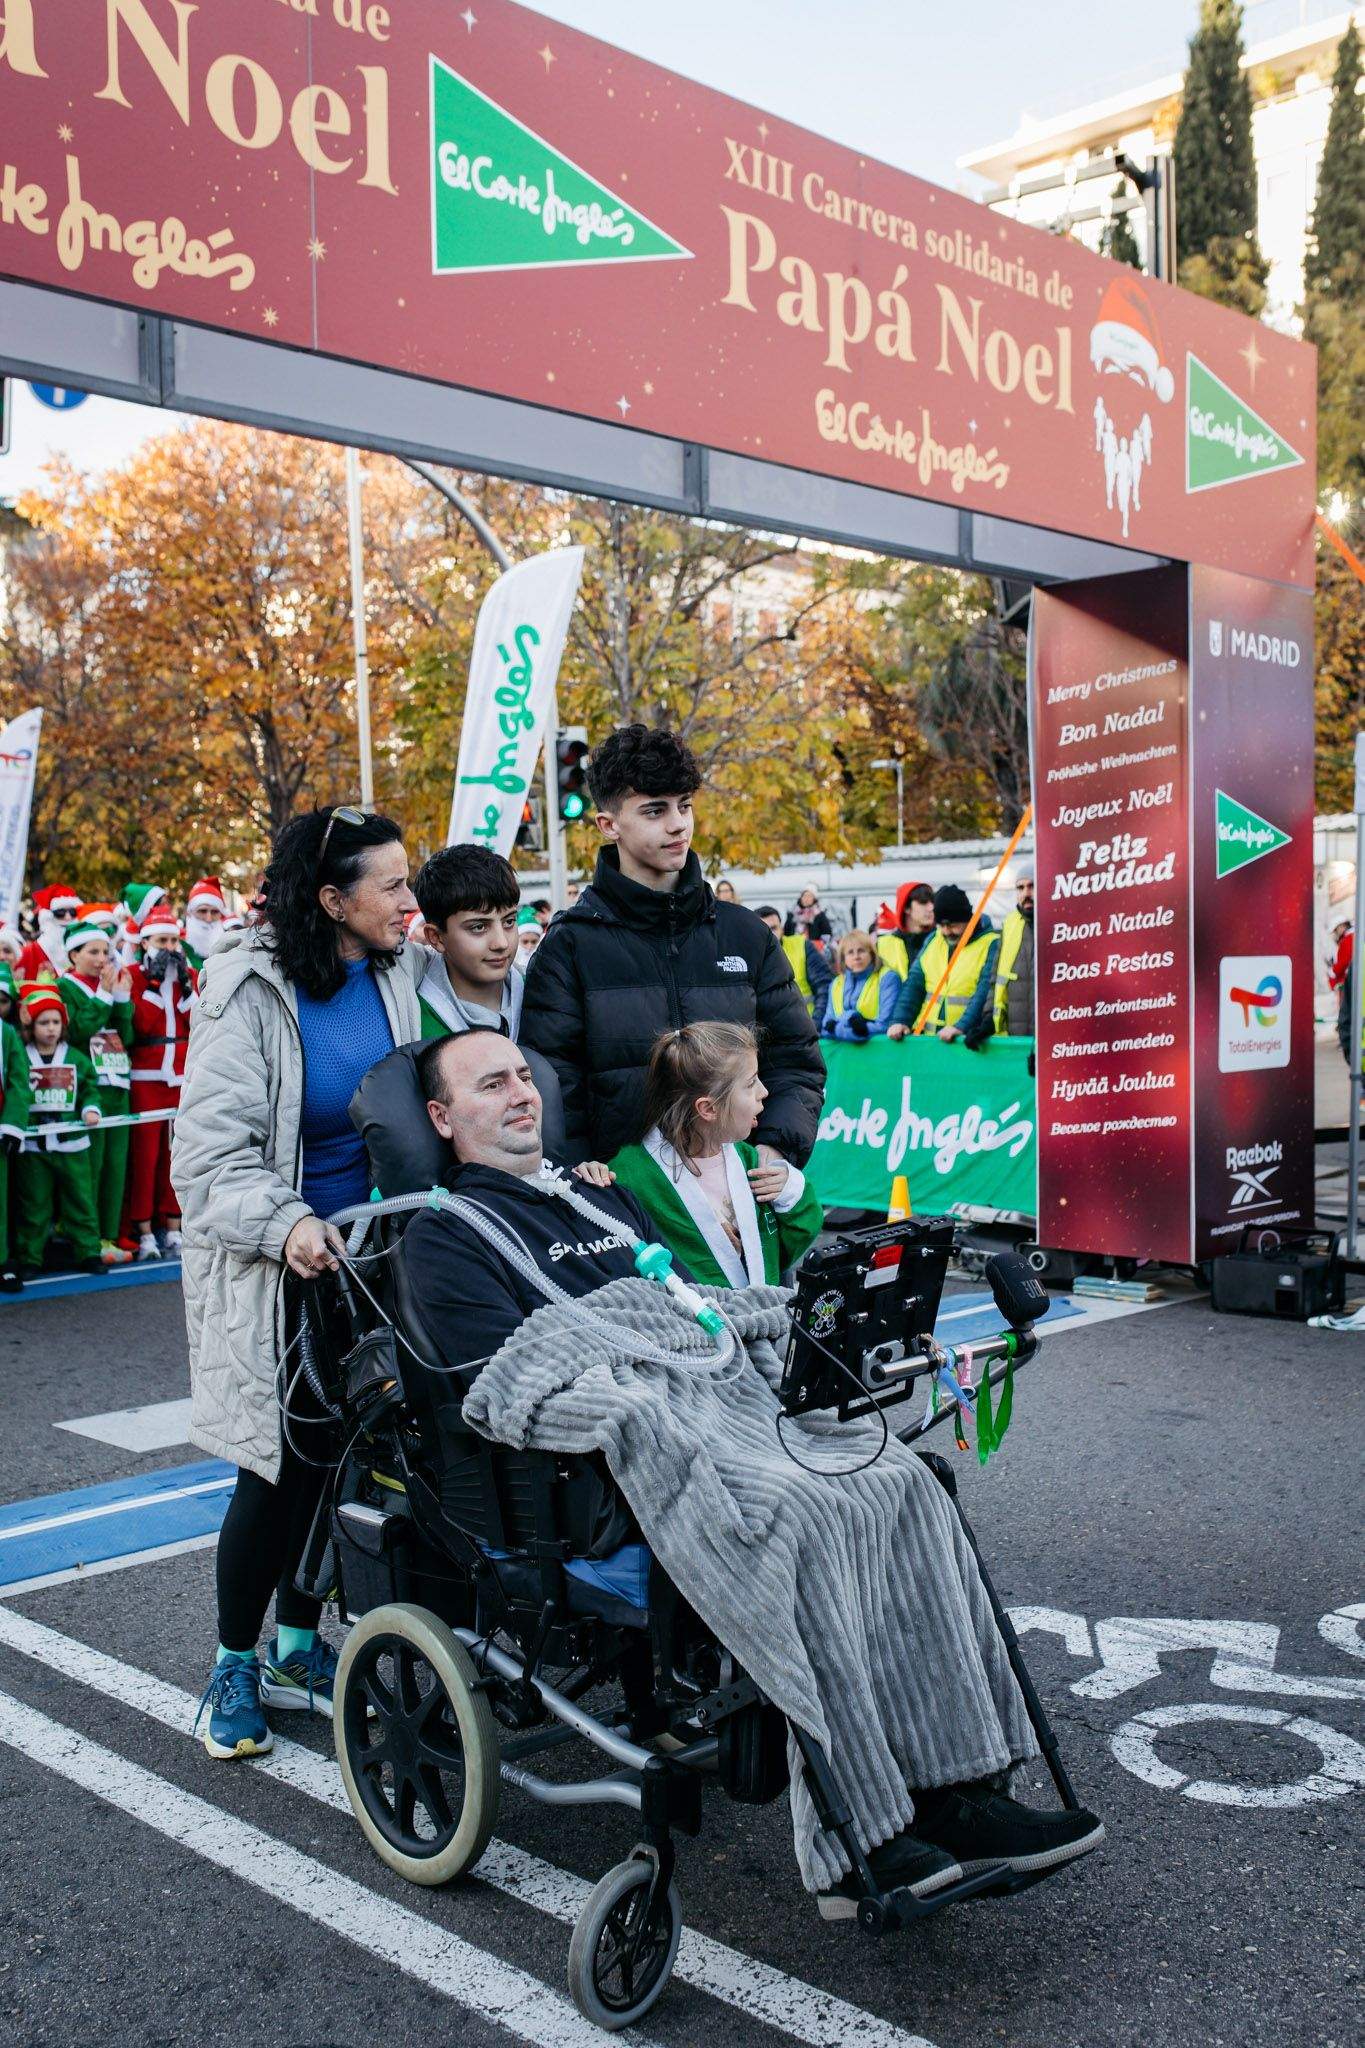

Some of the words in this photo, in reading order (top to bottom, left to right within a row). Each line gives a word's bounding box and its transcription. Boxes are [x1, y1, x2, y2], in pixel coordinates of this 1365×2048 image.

[94, 0, 399, 197] Noel
[438, 141, 471, 191] El
[471, 156, 541, 215] Corte
[542, 168, 635, 245] Inglés
[724, 137, 794, 203] XIII
[802, 172, 919, 251] Carrera
[925, 229, 1039, 298] solidaria
[1044, 269, 1074, 310] de
[720, 204, 918, 374] Papá
[934, 283, 1076, 416] Noel
[815, 388, 849, 444] El
[848, 401, 917, 464] Corte
[918, 408, 1010, 493] Inglés
[1204, 412, 1236, 448] Corte
[1235, 414, 1279, 463] Inglés
[1231, 628, 1301, 668] MADRID
[1047, 681, 1091, 705] Merry
[1095, 659, 1177, 691] Christmas
[1058, 723, 1098, 746] Bon
[1102, 700, 1165, 736] Nadal
[1047, 762, 1099, 784] Fröhliche
[1100, 744, 1177, 770] Weihnachten
[1051, 799, 1123, 828] Joyeux
[1127, 782, 1173, 812] Noël
[1075, 833, 1148, 869] Feliz
[1051, 852, 1176, 901] Navidad
[1051, 922, 1102, 944] Buon
[1106, 906, 1175, 935] Natale
[1051, 962, 1101, 983] Boas
[1105, 950, 1175, 976] Festas
[1050, 1005, 1092, 1022] Gabon
[1094, 992, 1177, 1017] Zoriontsuak
[1051, 1041, 1109, 1059] Shinnen
[1111, 1032, 1175, 1052] omedeto
[1229, 1039, 1282, 1055] TotalEnergies
[1051, 1076, 1109, 1102] Hyvää
[1112, 1070, 1176, 1093] Joulua
[816, 1092, 888, 1149] orte
[886, 1075, 1034, 1175] Inglés
[1226, 1140, 1283, 1172] Reebok
